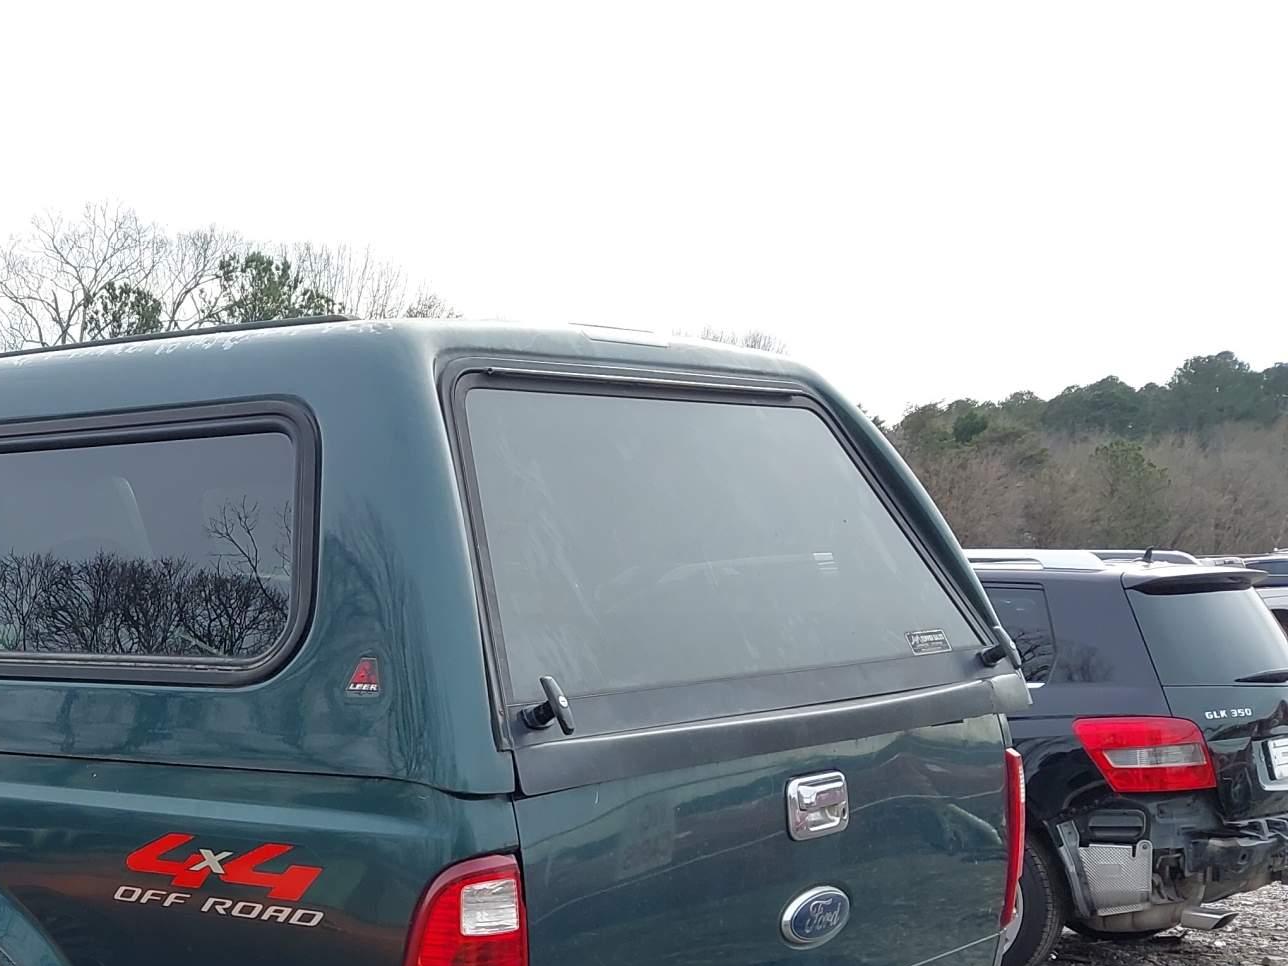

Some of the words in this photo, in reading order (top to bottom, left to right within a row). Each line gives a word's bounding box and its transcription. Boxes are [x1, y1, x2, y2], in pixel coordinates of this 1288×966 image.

[348, 683, 378, 691] LEER
[1204, 709, 1228, 719] GLK
[1230, 708, 1252, 717] 350
[113, 885, 191, 907] OFF
[201, 897, 325, 928] ROAD
[804, 897, 842, 934] Ford
